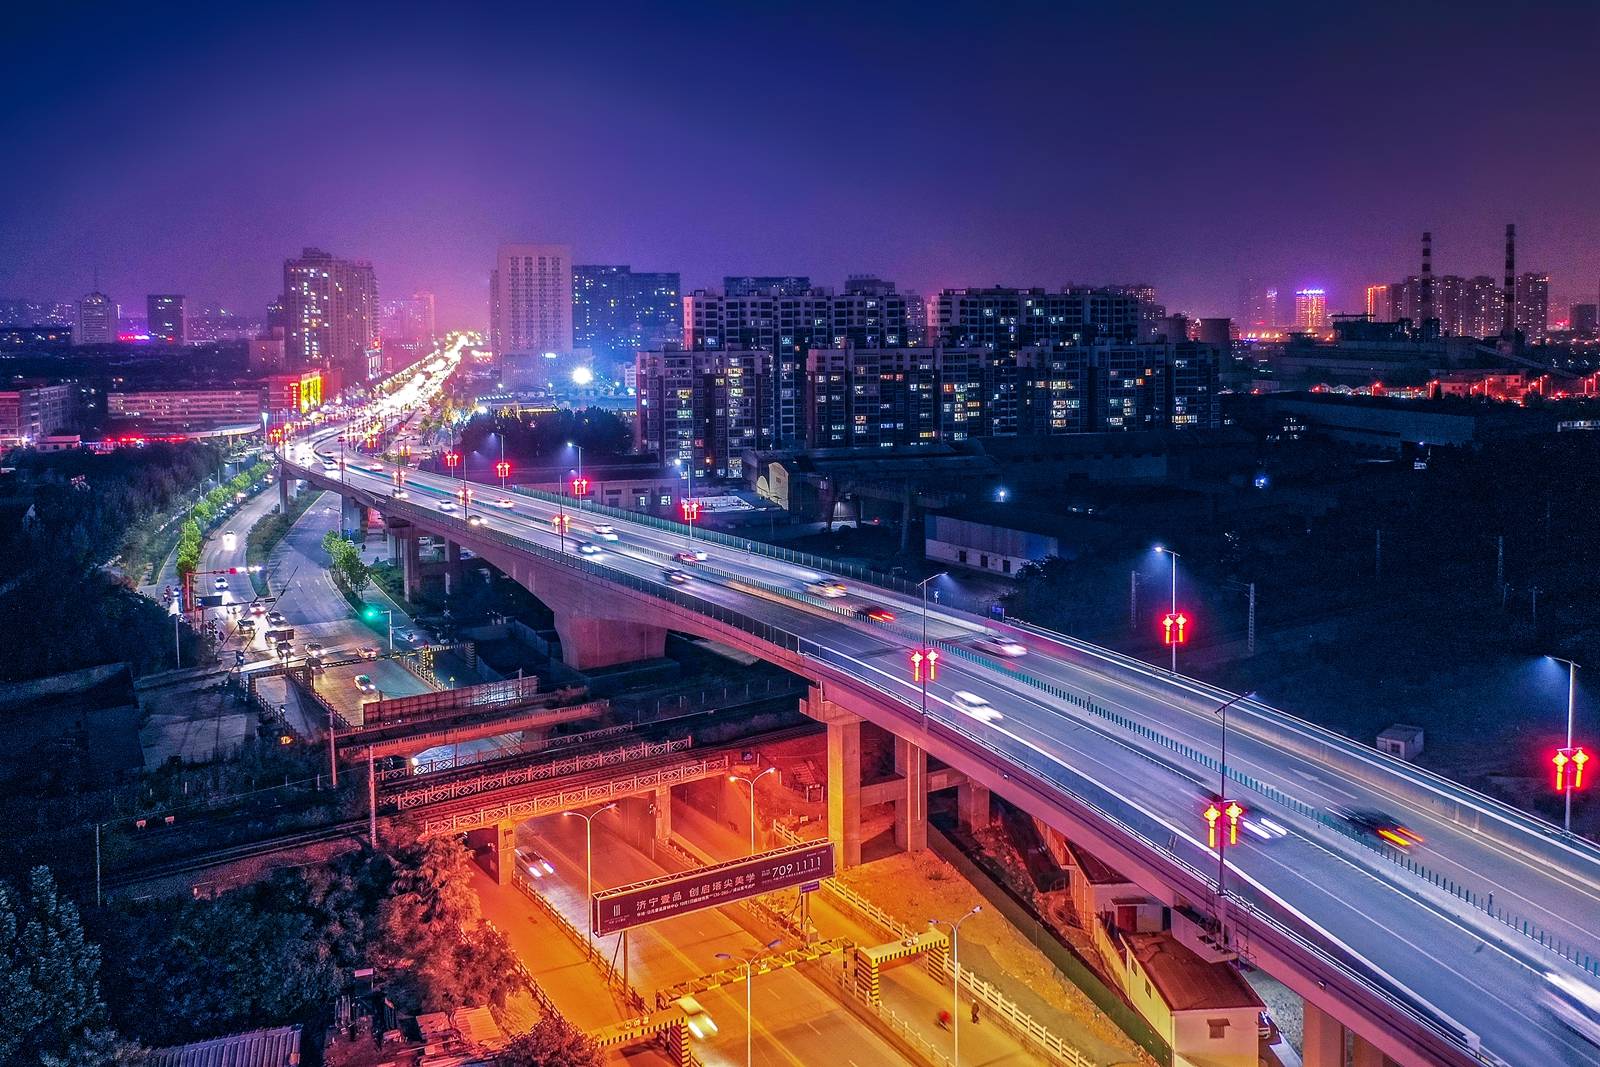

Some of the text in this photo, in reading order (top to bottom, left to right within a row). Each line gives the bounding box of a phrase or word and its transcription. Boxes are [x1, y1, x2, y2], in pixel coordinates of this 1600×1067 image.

[636, 891, 682, 911] 济宁壹品
[689, 872, 756, 897] 创启塔尖美学
